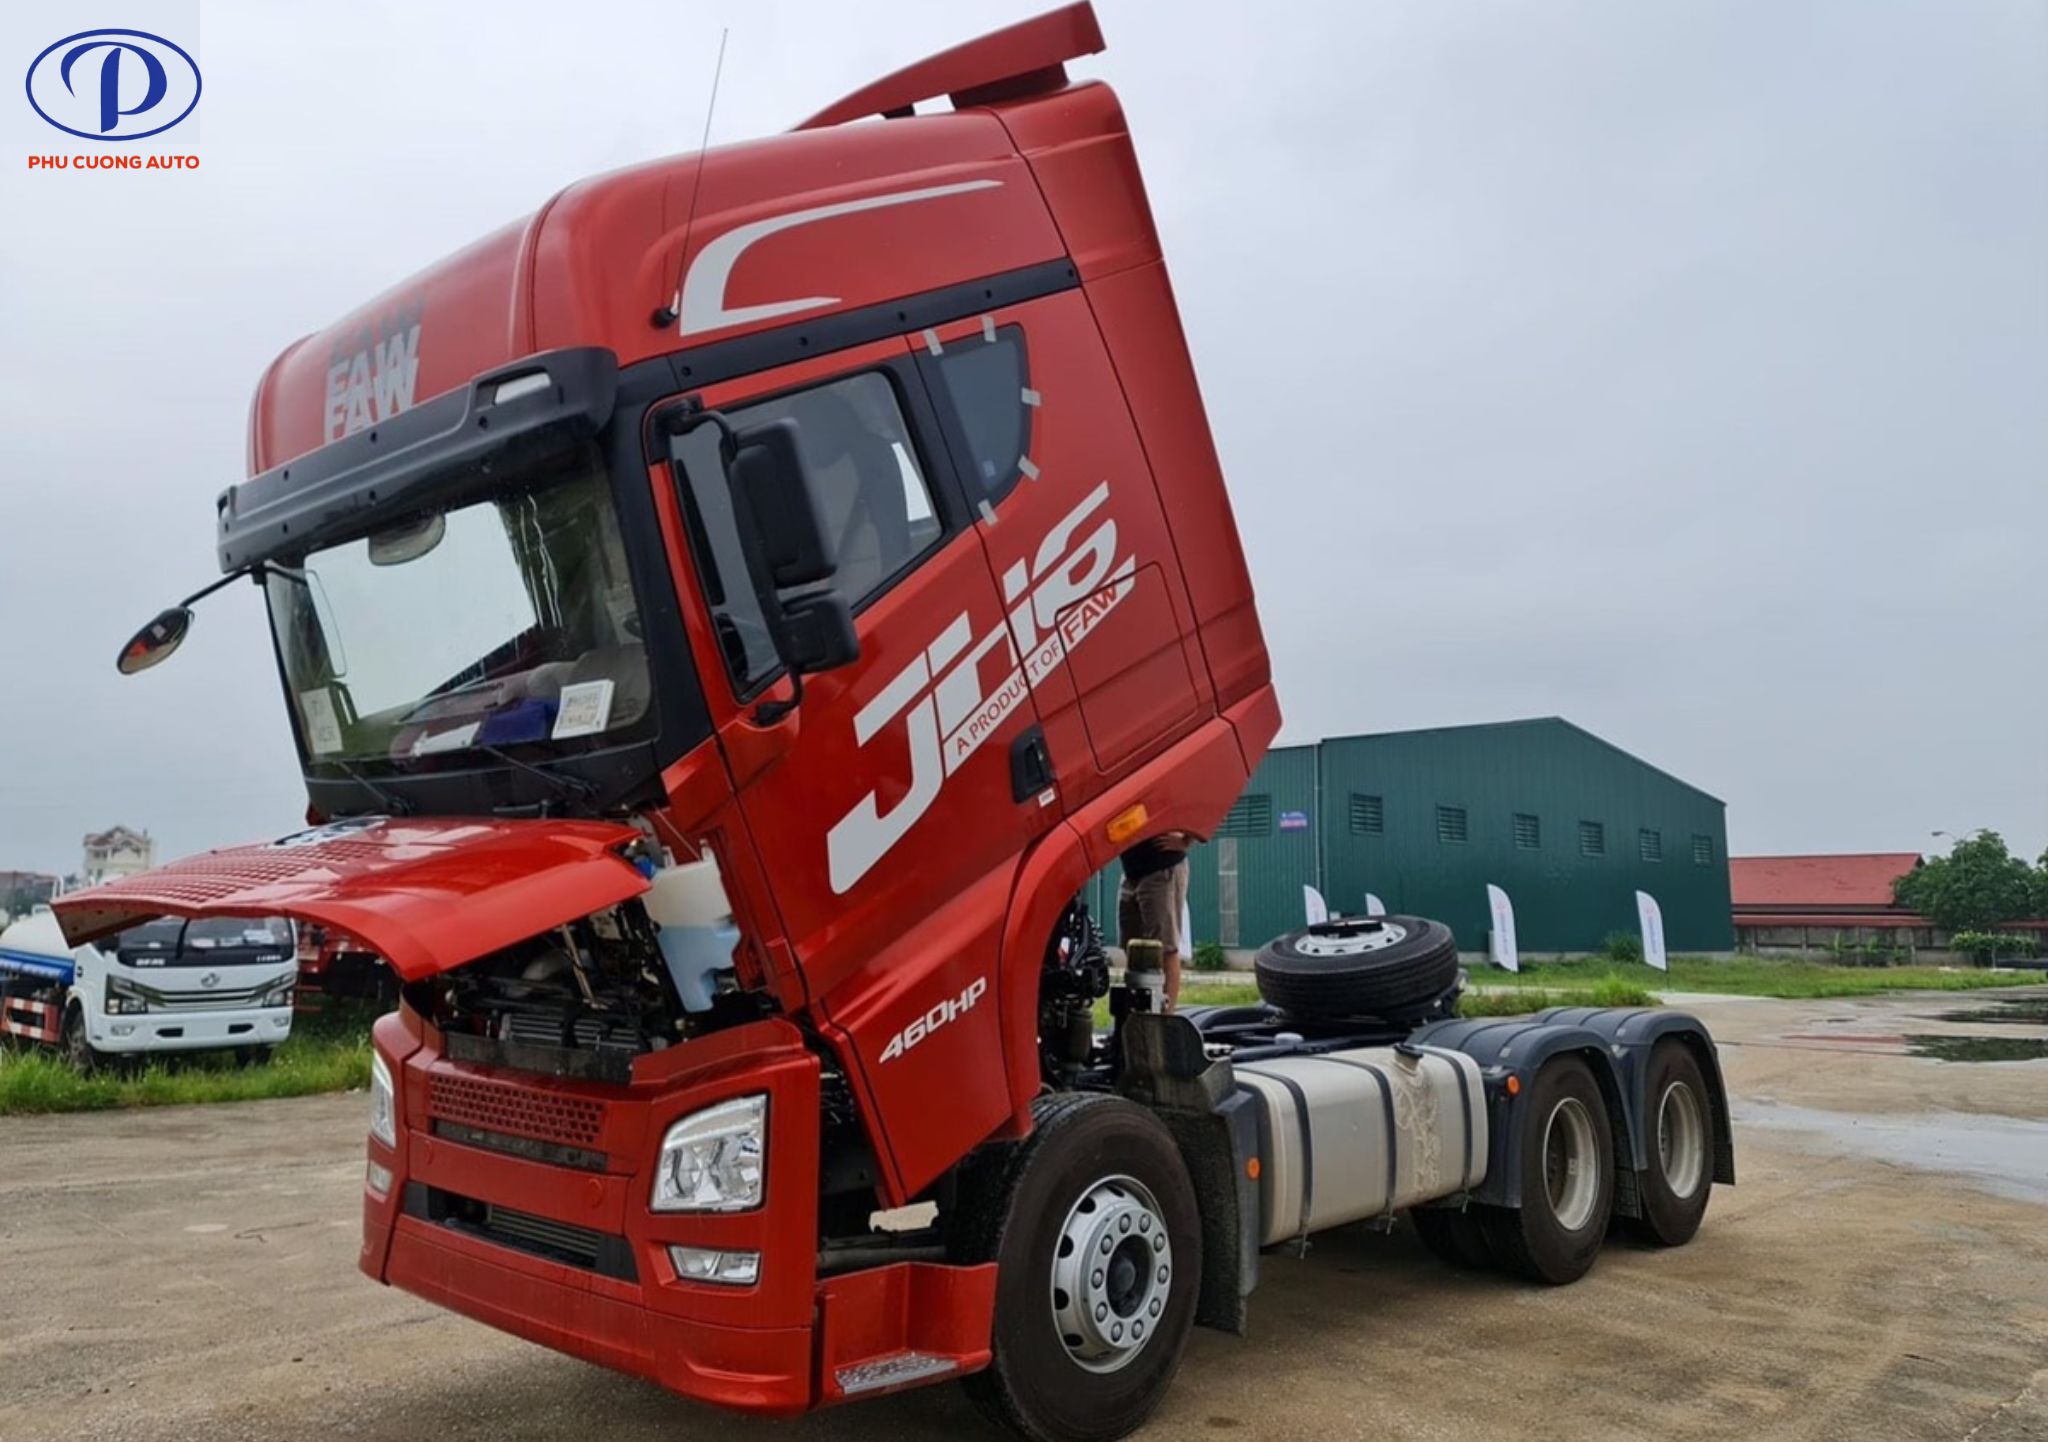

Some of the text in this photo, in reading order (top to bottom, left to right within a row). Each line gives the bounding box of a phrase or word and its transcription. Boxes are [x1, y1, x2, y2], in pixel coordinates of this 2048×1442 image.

[956, 578, 1118, 756] A PRODUCT OF FAW
[878, 976, 987, 1064] 460HP
